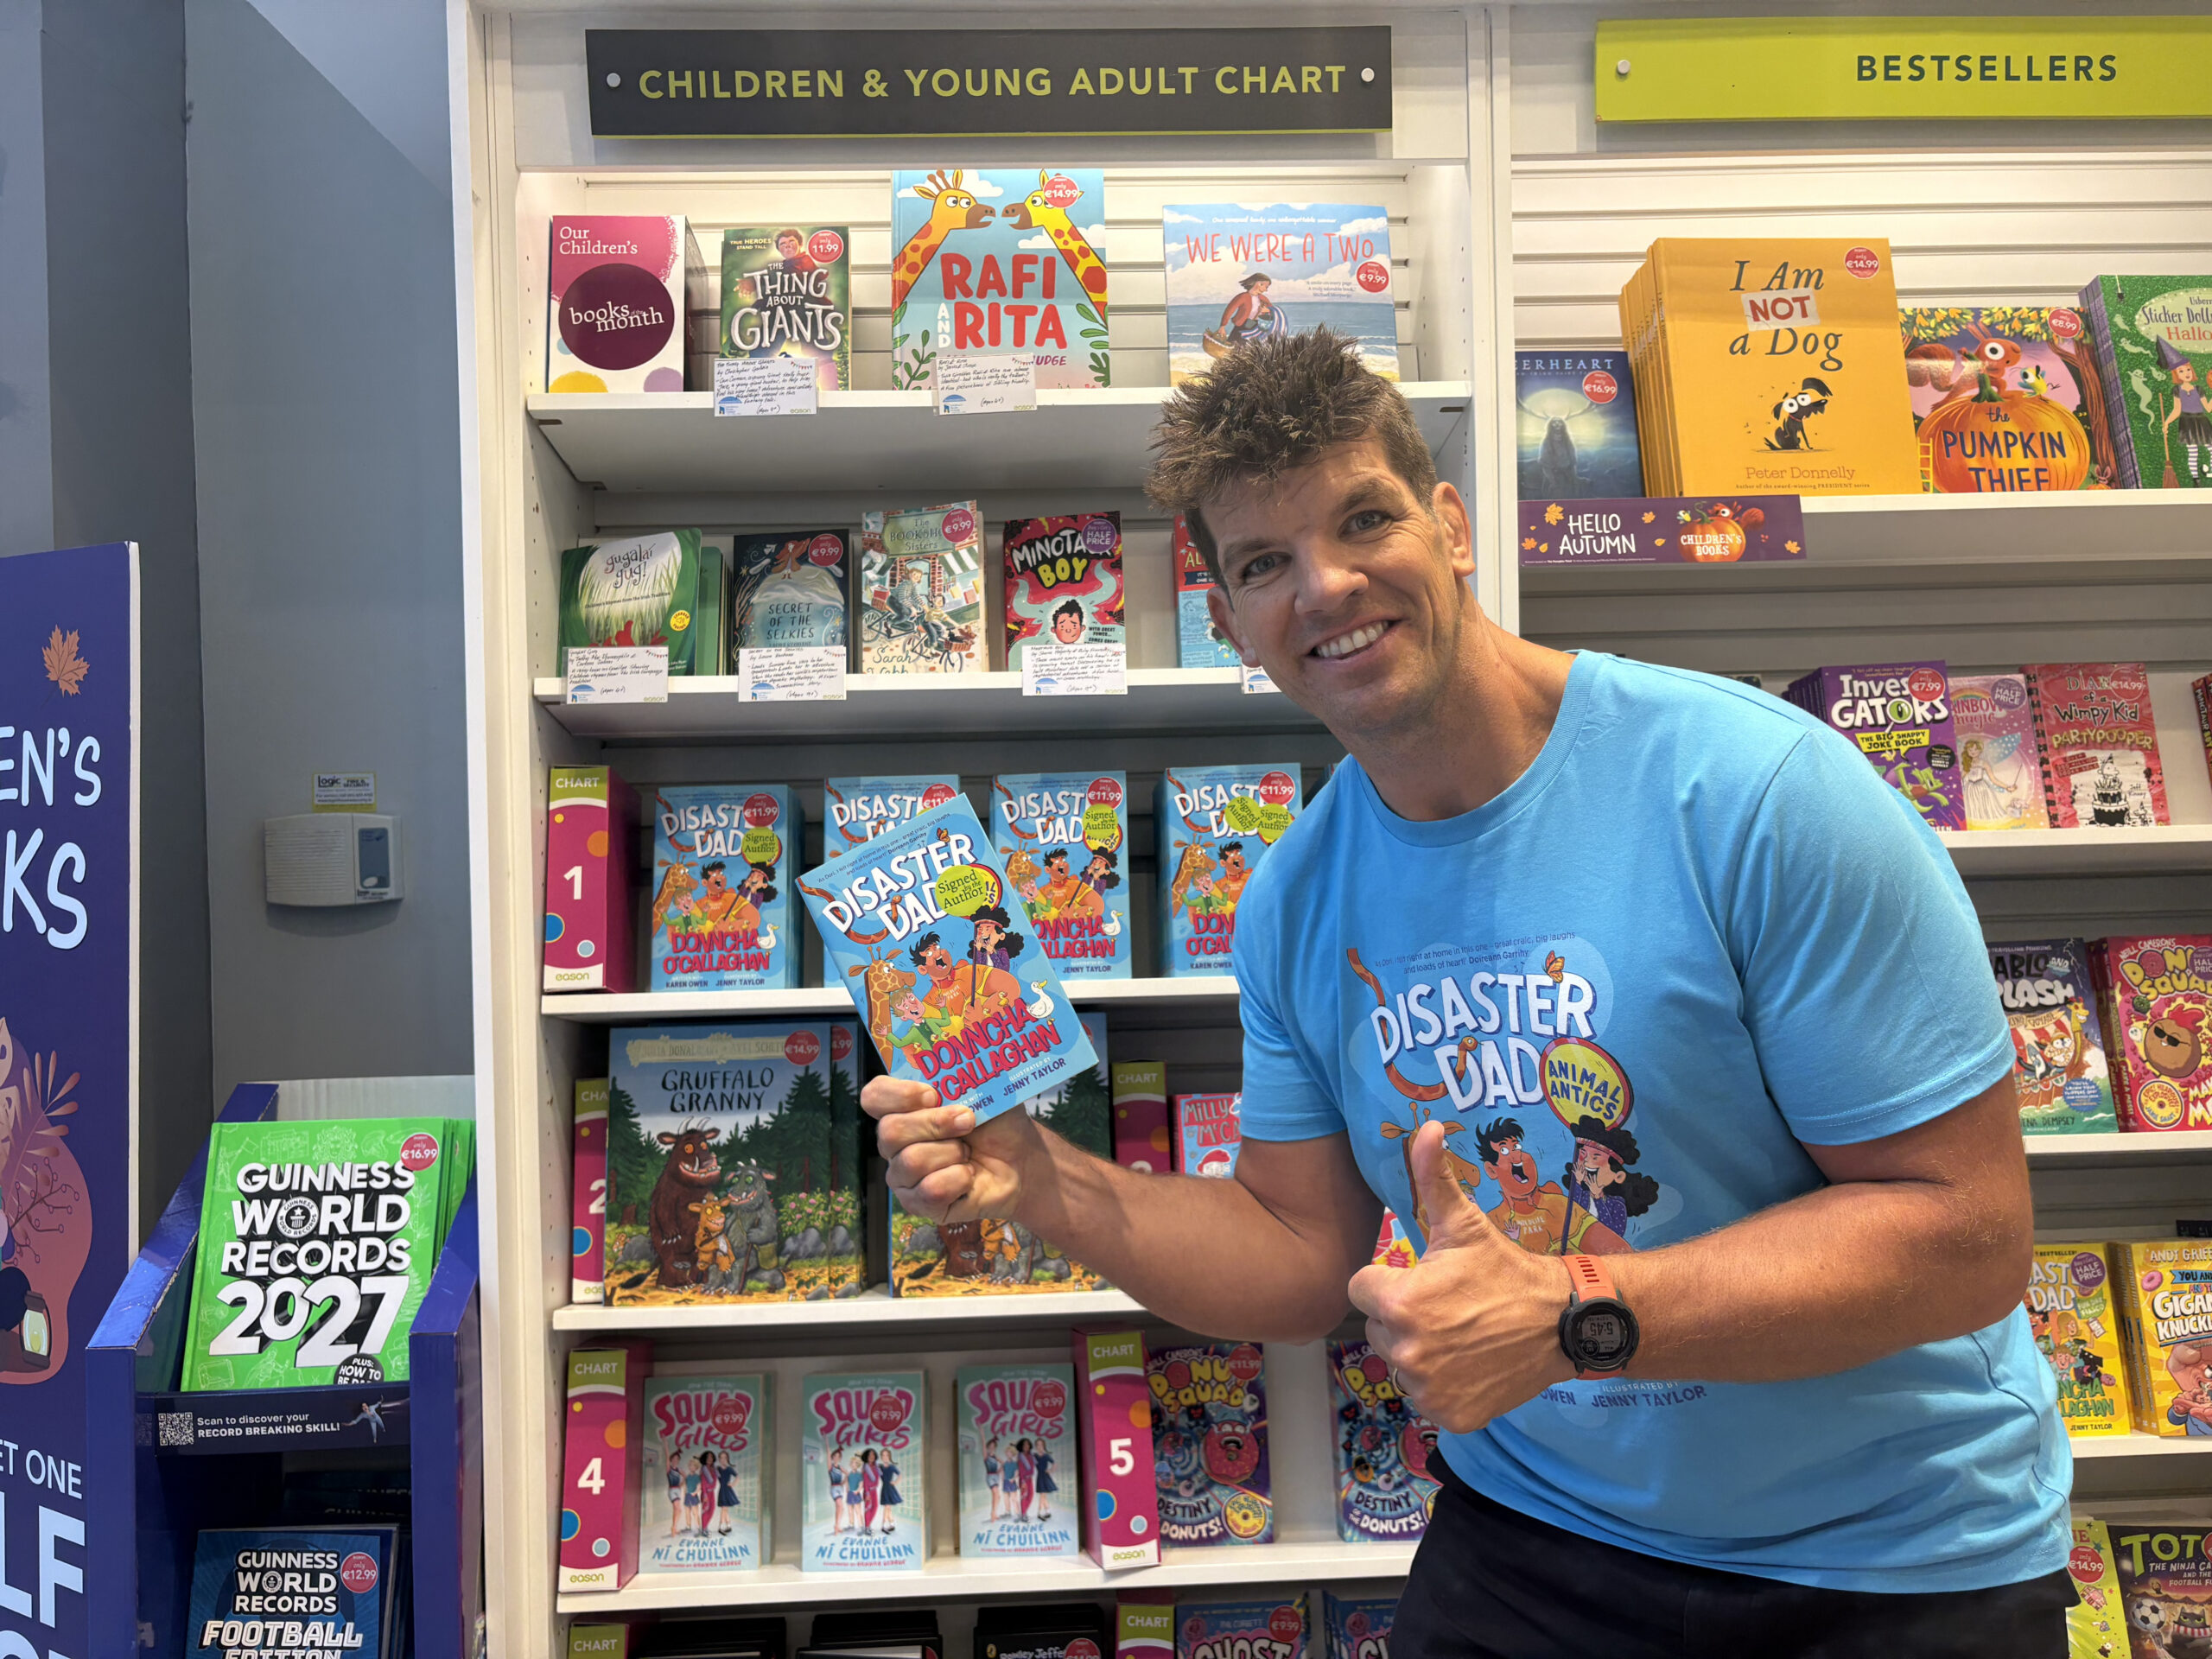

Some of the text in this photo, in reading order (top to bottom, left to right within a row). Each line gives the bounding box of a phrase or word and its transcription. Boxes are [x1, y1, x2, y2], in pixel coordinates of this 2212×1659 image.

[1857, 54, 2118, 82] BESTSELLERS
[639, 65, 1346, 99] CHILDREN & YOUNG ADULT CHART
[559, 226, 590, 239] Our
[559, 239, 638, 255] Children's
[1185, 232, 1374, 264] WE WERE A TWO
[767, 262, 784, 270] THE
[1846, 260, 1878, 270] €14.99
[743, 269, 829, 300] THING
[940, 253, 1056, 300] RAFI
[1729, 260, 1825, 291] I Am
[766, 296, 804, 308] ABOUT
[1749, 295, 1811, 322] NOT
[569, 301, 631, 325] books
[595, 307, 664, 333] month
[2142, 305, 2183, 326] Sticker
[731, 302, 844, 351] GIANTS
[954, 301, 1067, 350] RITA
[1729, 327, 1844, 372] a Dog
[1986, 406, 2010, 423] the
[1942, 430, 2066, 459] PUMPKIN
[1745, 466, 1856, 480] Peter Donnelly
[944, 520, 971, 534] €9.99
[1567, 513, 1621, 535] HELLO
[1086, 529, 1111, 538] HALF
[1086, 537, 1111, 546] PRICE
[1680, 533, 1742, 546] CHILDREN'S
[812, 547, 839, 556] €9.99
[905, 541, 938, 551] Sisters
[1559, 533, 1637, 556] AUTUMN
[1695, 543, 1730, 556] BOOKS
[604, 543, 657, 575] gugalaí
[613, 560, 646, 588] gug!
[1038, 557, 1088, 588] BOY
[768, 603, 813, 614] SECRET
[769, 614, 811, 627] OF THE
[766, 627, 814, 640] SELKIES
[873, 646, 912, 664] Sarah
[1995, 688, 2021, 698] HALF
[2083, 692, 2096, 702] of
[2054, 701, 2139, 726] Wimpy Kid
[1867, 739, 1922, 749] JOKE BOOK
[1876, 734, 1893, 742] BIG
[2051, 728, 2154, 750] PARTYPOOPER
[318, 775, 341, 788] Logic
[556, 778, 600, 788] CHART
[1088, 791, 1122, 802] €11.99
[744, 807, 778, 817] €11.99
[935, 813, 950, 824] laughs
[1085, 810, 1115, 823] Signed
[1260, 810, 1289, 823] Signed
[1034, 817, 1084, 845] DAD
[1085, 821, 1116, 831] Author
[746, 833, 775, 844] Signed
[745, 843, 776, 854] Author
[887, 842, 909, 855] Doireann
[563, 865, 582, 900] 1
[822, 833, 977, 935] DISASTER
[938, 869, 978, 894] Signed
[943, 886, 984, 909] Author
[671, 929, 761, 953] DONNCHA
[1432, 931, 1576, 958] home laughs
[2138, 938, 2177, 950] CAMERON'S
[663, 952, 771, 975] O'CALLAGHAN
[1403, 949, 1529, 975] and loads Doireann Garrihy
[556, 972, 589, 982] eason
[1370, 970, 1598, 1065] DISASTER
[914, 997, 1038, 1080] DONNCHA
[785, 1045, 819, 1055] €14.99
[661, 1067, 774, 1091] GRUFFALO
[1003, 1058, 1067, 1096] JENNY TAYLOR
[1009, 1061, 1042, 1081] ILLUSTRATED
[1117, 1072, 1158, 1084] CHART
[1433, 1037, 1546, 1113] DAD
[1548, 1059, 1622, 1103] ANIMAL
[670, 1090, 766, 1113] GRANNY
[1549, 1081, 1618, 1120] ANTICS
[2042, 1116, 2075, 1126] DEMPSEY
[401, 1147, 437, 1160] €16.99
[236, 1160, 415, 1193] GUINNESS
[589, 1179, 606, 1214] 2
[231, 1193, 410, 1239] WORLD
[221, 1237, 411, 1276] RECORDS
[2151, 1249, 2178, 1262] ANDY
[2076, 1262, 2100, 1274] HALF
[2078, 1270, 2102, 1282] PRICE
[2178, 1271, 2198, 1281] YOU
[2031, 1286, 2075, 1313] DAD
[208, 1275, 410, 1369] 2027
[1093, 1344, 1135, 1359] CHART
[340, 1365, 381, 1380] HOW TO
[574, 1363, 618, 1375] CHART
[1592, 1385, 1707, 1408] JENNY TAYLOR
[1602, 1382, 1663, 1393] ILLUSTRATED
[197, 1413, 309, 1426] Scan to discover your
[715, 1414, 744, 1424] €9.99
[873, 1410, 901, 1421] €9.99
[198, 1423, 340, 1439] RECORD BREAKING SKILL!
[1109, 1437, 1135, 1476] 5
[25, 1449, 83, 1500] ONE
[577, 1458, 606, 1495] 4
[1157, 1497, 1211, 1518] DESTINY
[1355, 1490, 1412, 1511] DESTINY
[1160, 1516, 1224, 1541] DONUTS!
[678, 1538, 724, 1548] EVANNE
[238, 1552, 339, 1570] GUINNESS
[675, 1543, 750, 1562] CHUILINN
[343, 1569, 377, 1581] €12.99
[2069, 1560, 2104, 1573] €14.99
[2150, 1561, 2196, 1572] THE NINJA
[238, 1570, 338, 1593] WORLD
[569, 1572, 605, 1583] eason
[233, 1595, 337, 1613] RECORDS
[1128, 1615, 1170, 1628] CHART
[201, 1620, 363, 1649] FOOTBALL
